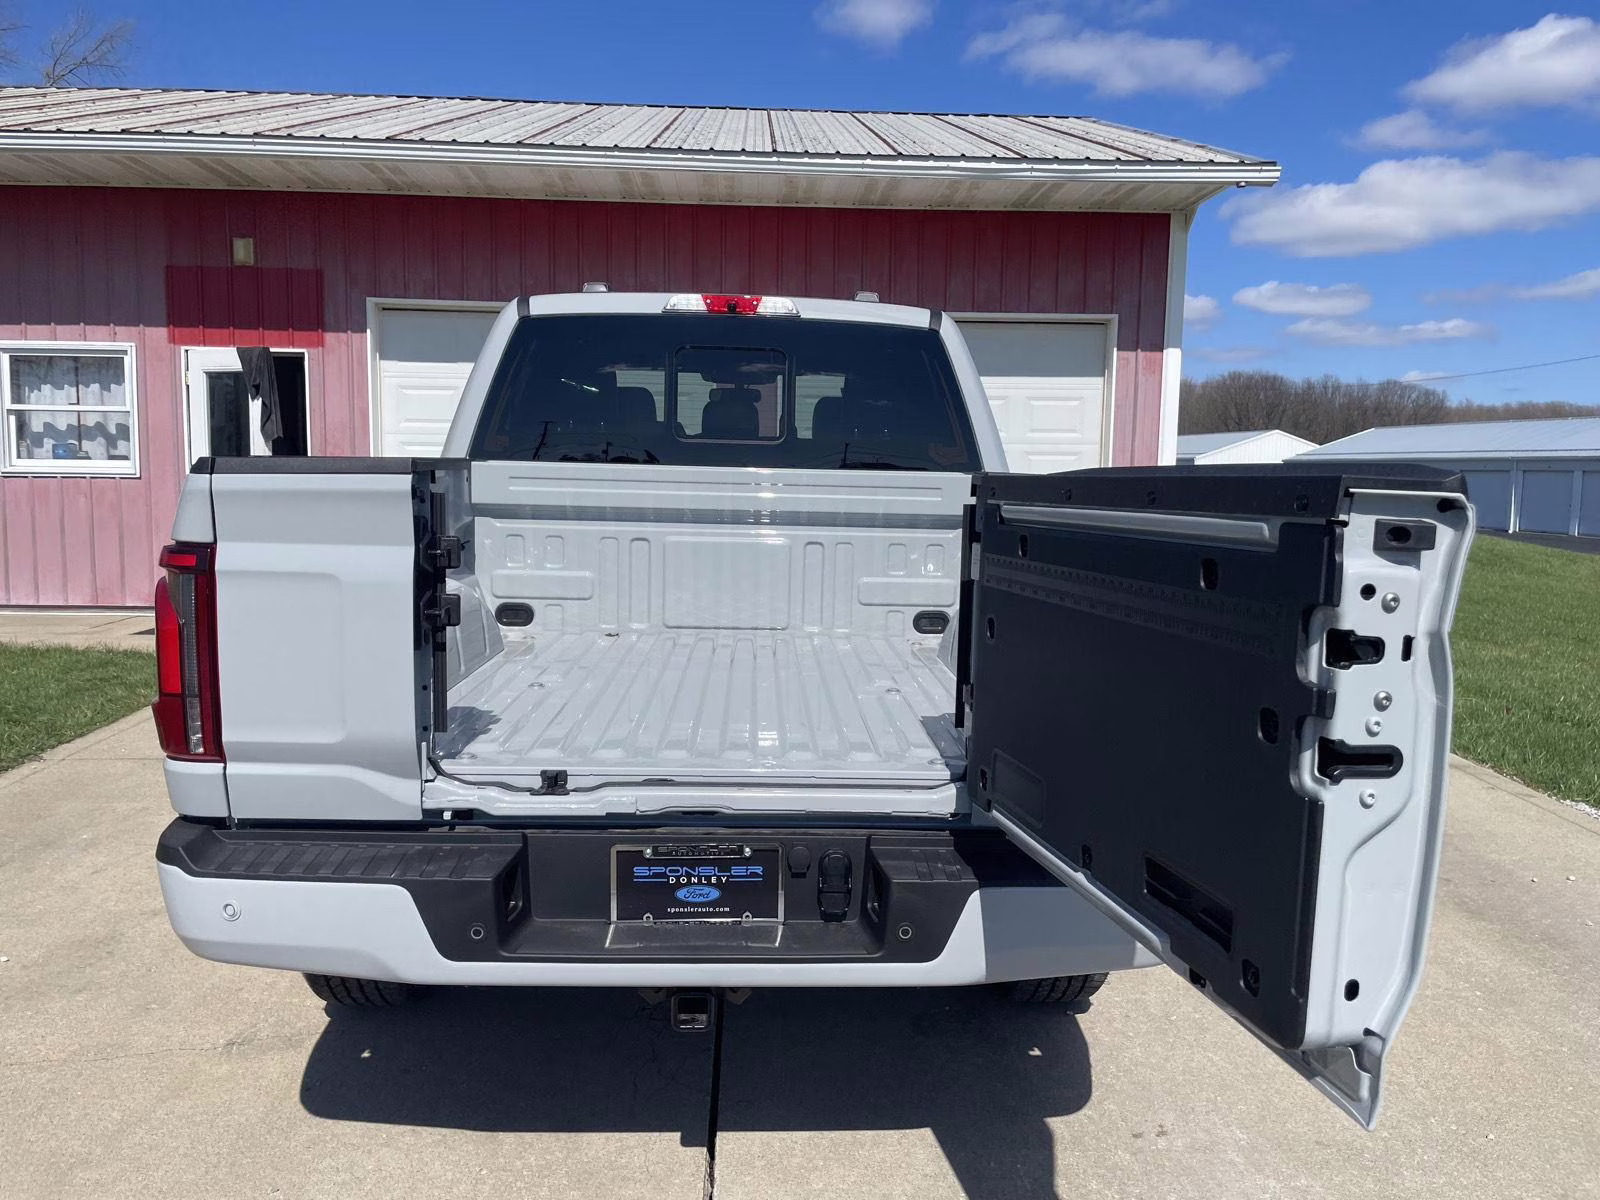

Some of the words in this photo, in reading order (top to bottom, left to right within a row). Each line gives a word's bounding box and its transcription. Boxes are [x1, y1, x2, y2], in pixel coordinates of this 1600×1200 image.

[633, 866, 763, 876] SPONSLER
[669, 876, 728, 884] DONLEY
[683, 888, 711, 900] Ford
